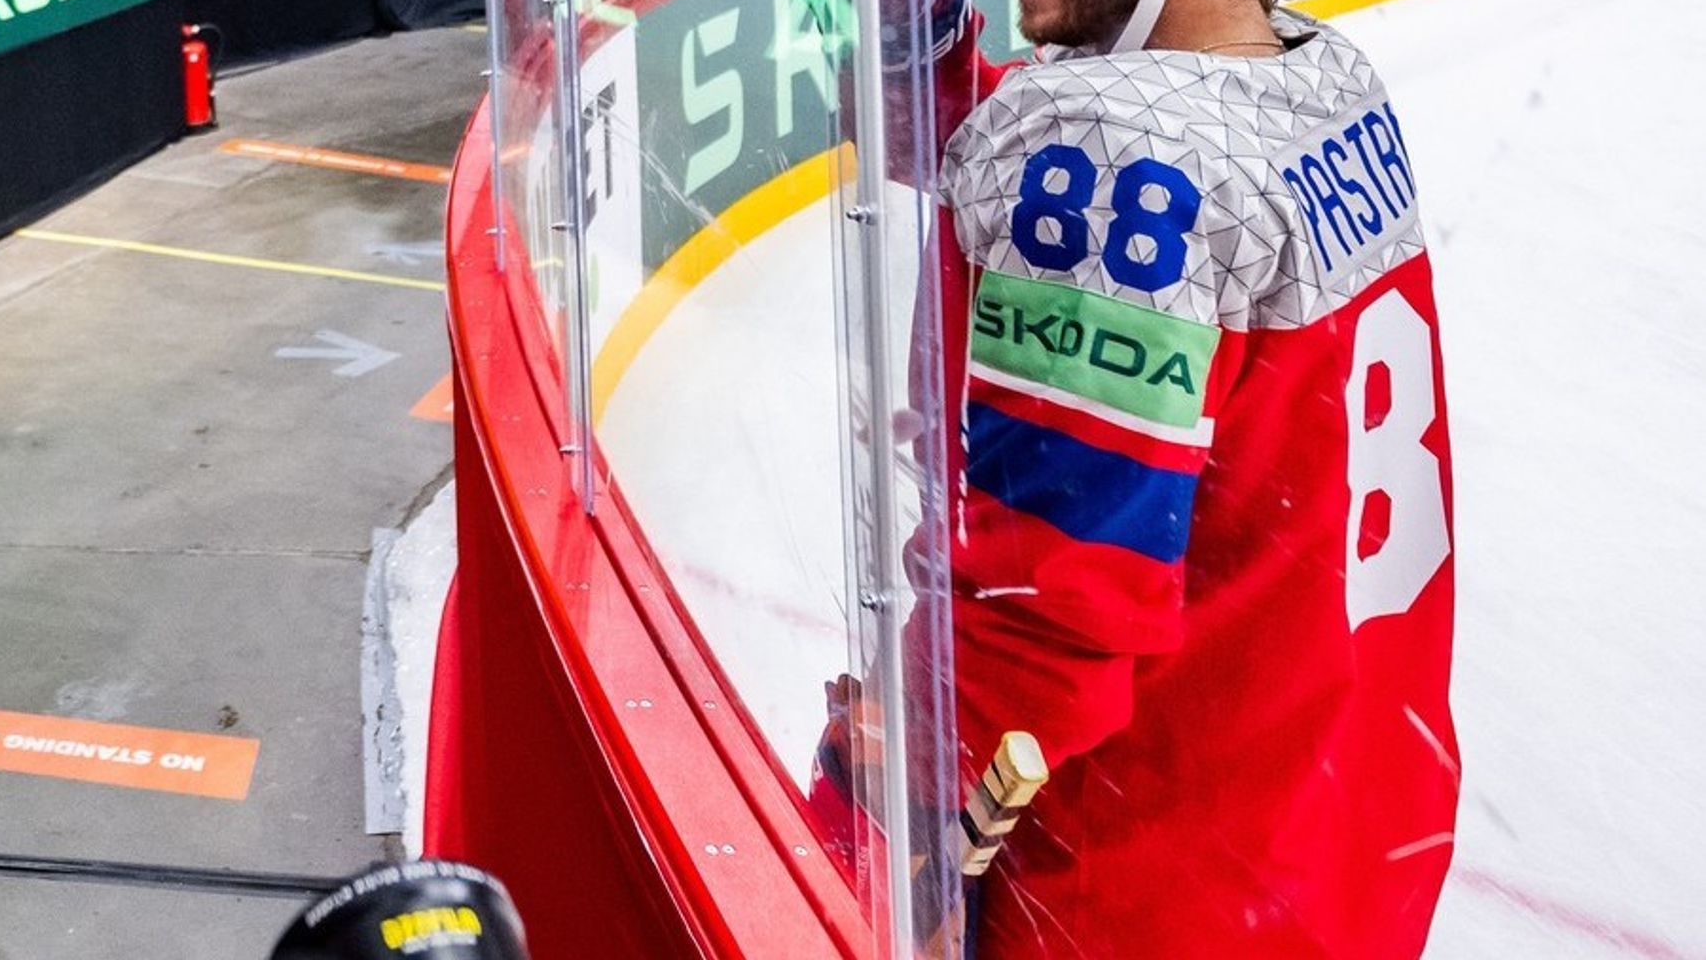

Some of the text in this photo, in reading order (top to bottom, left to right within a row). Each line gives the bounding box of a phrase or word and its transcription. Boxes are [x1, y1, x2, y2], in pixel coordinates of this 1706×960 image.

[1011, 142, 1204, 294] 88
[973, 296, 1196, 396] SKODA
[3, 733, 152, 766] STANDING
[159, 754, 206, 772] NO
